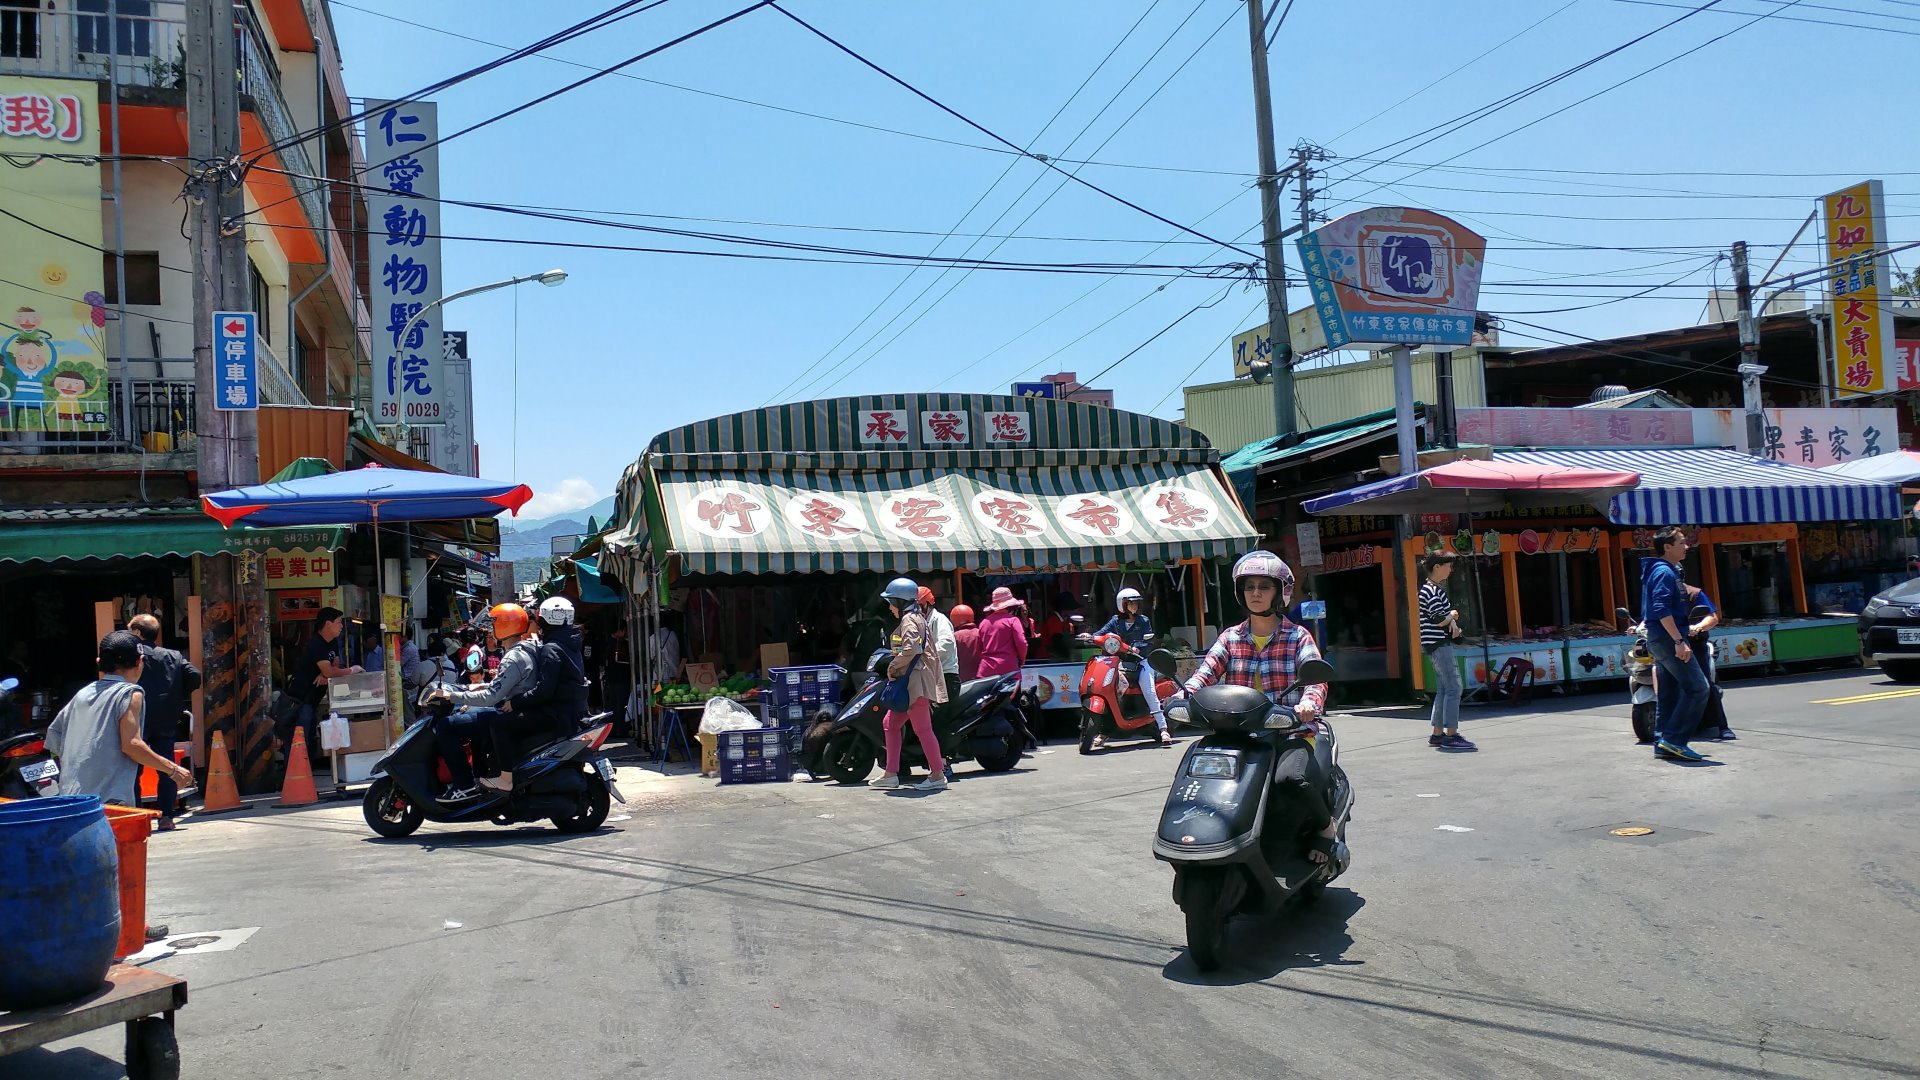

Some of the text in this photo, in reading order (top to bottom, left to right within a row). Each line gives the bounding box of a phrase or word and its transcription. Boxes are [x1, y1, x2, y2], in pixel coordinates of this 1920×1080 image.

[1834, 194, 1866, 250] 九如
[379, 107, 432, 396] 仁愛動物醫院
[1352, 315, 1468, 333] 竹東客家傳統市集
[1843, 297, 1873, 388] 大賣場
[224, 340, 247, 405] 停車場
[381, 402, 440, 417] 590029
[865, 412, 1027, 441] 承蒙您
[697, 491, 1209, 539] 竹東客家市集
[265, 557, 331, 579] 營業中
